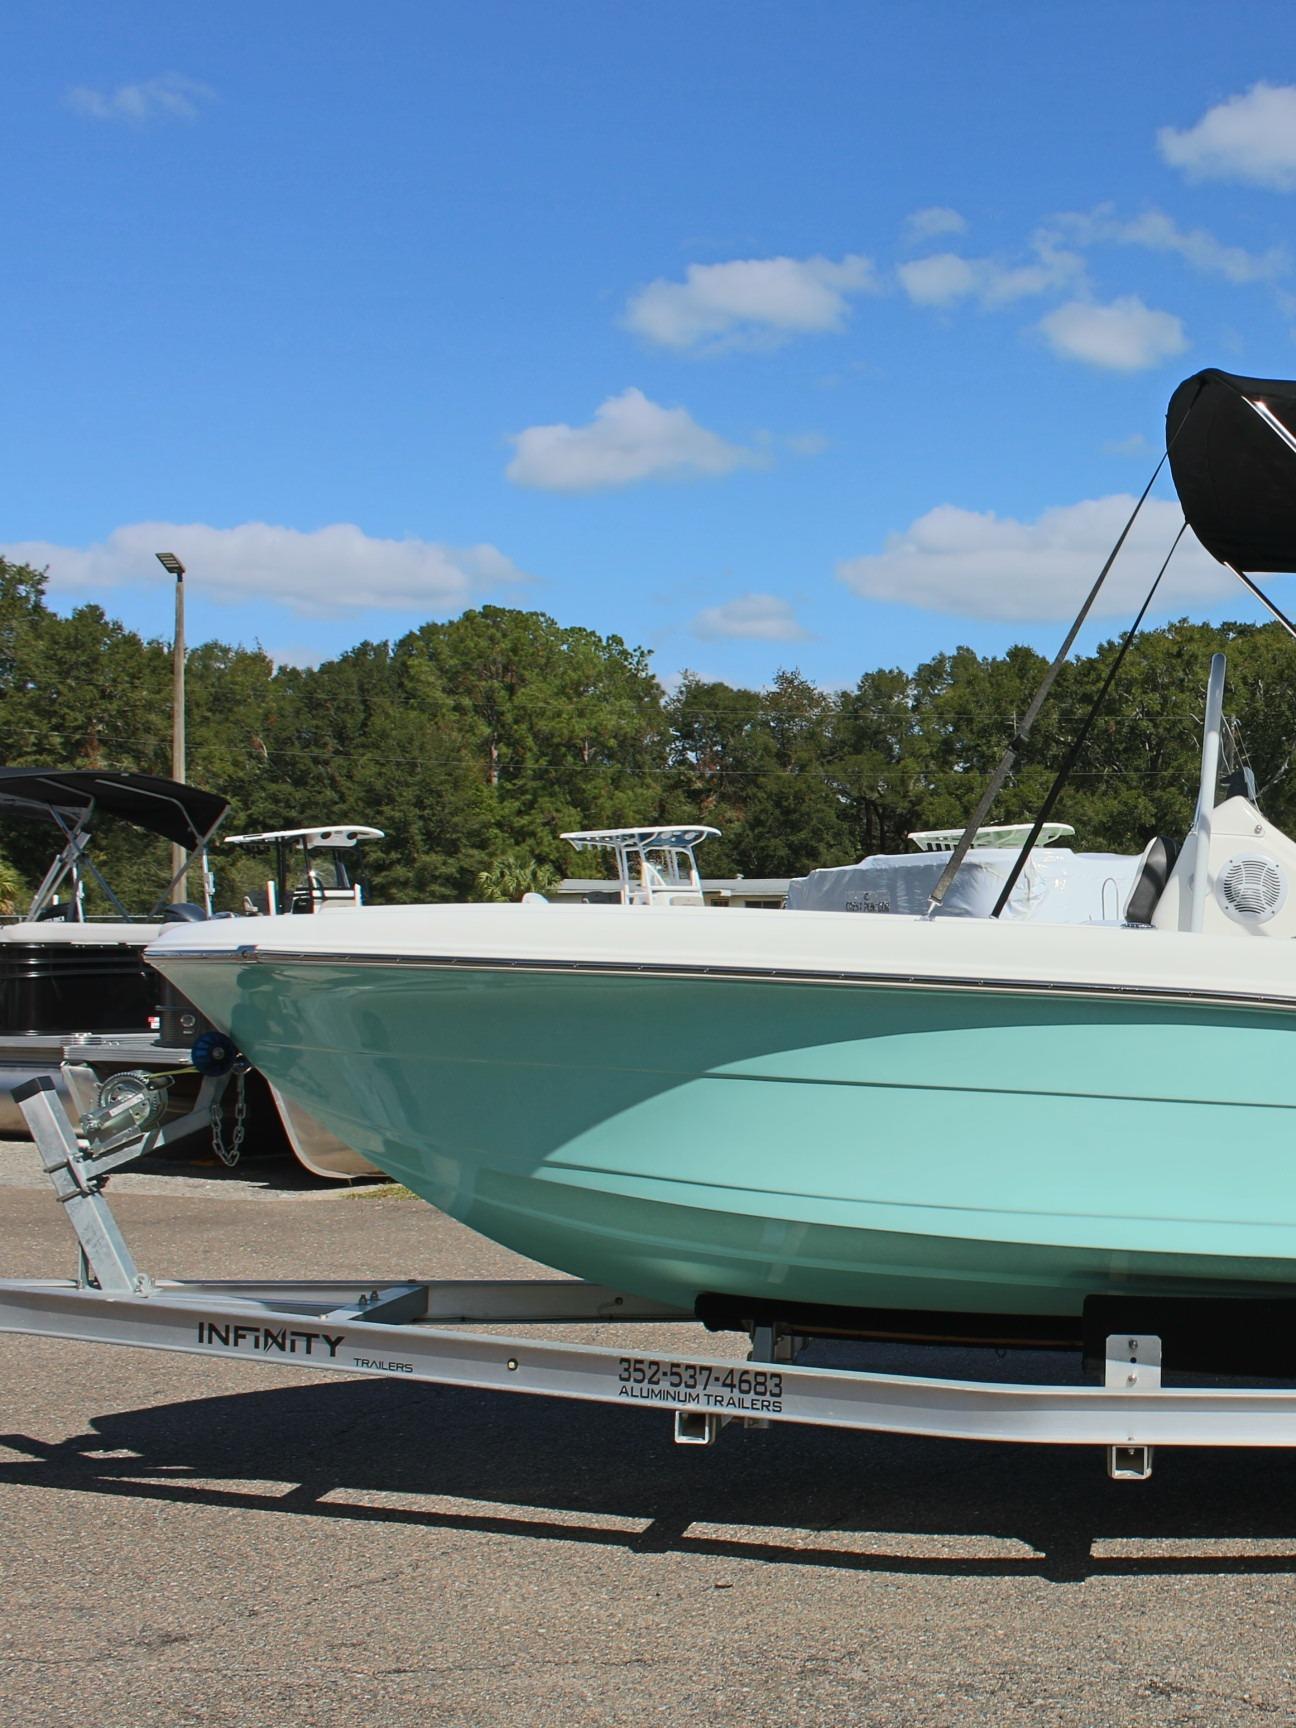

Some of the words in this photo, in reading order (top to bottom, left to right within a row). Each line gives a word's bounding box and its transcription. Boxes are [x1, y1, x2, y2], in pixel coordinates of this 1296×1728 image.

[353, 1357, 414, 1373] TRAILERS
[618, 1357, 783, 1398] 352-537-4683
[618, 1385, 700, 1405] ALUMINUM
[703, 1393, 783, 1413] TRAILERS
